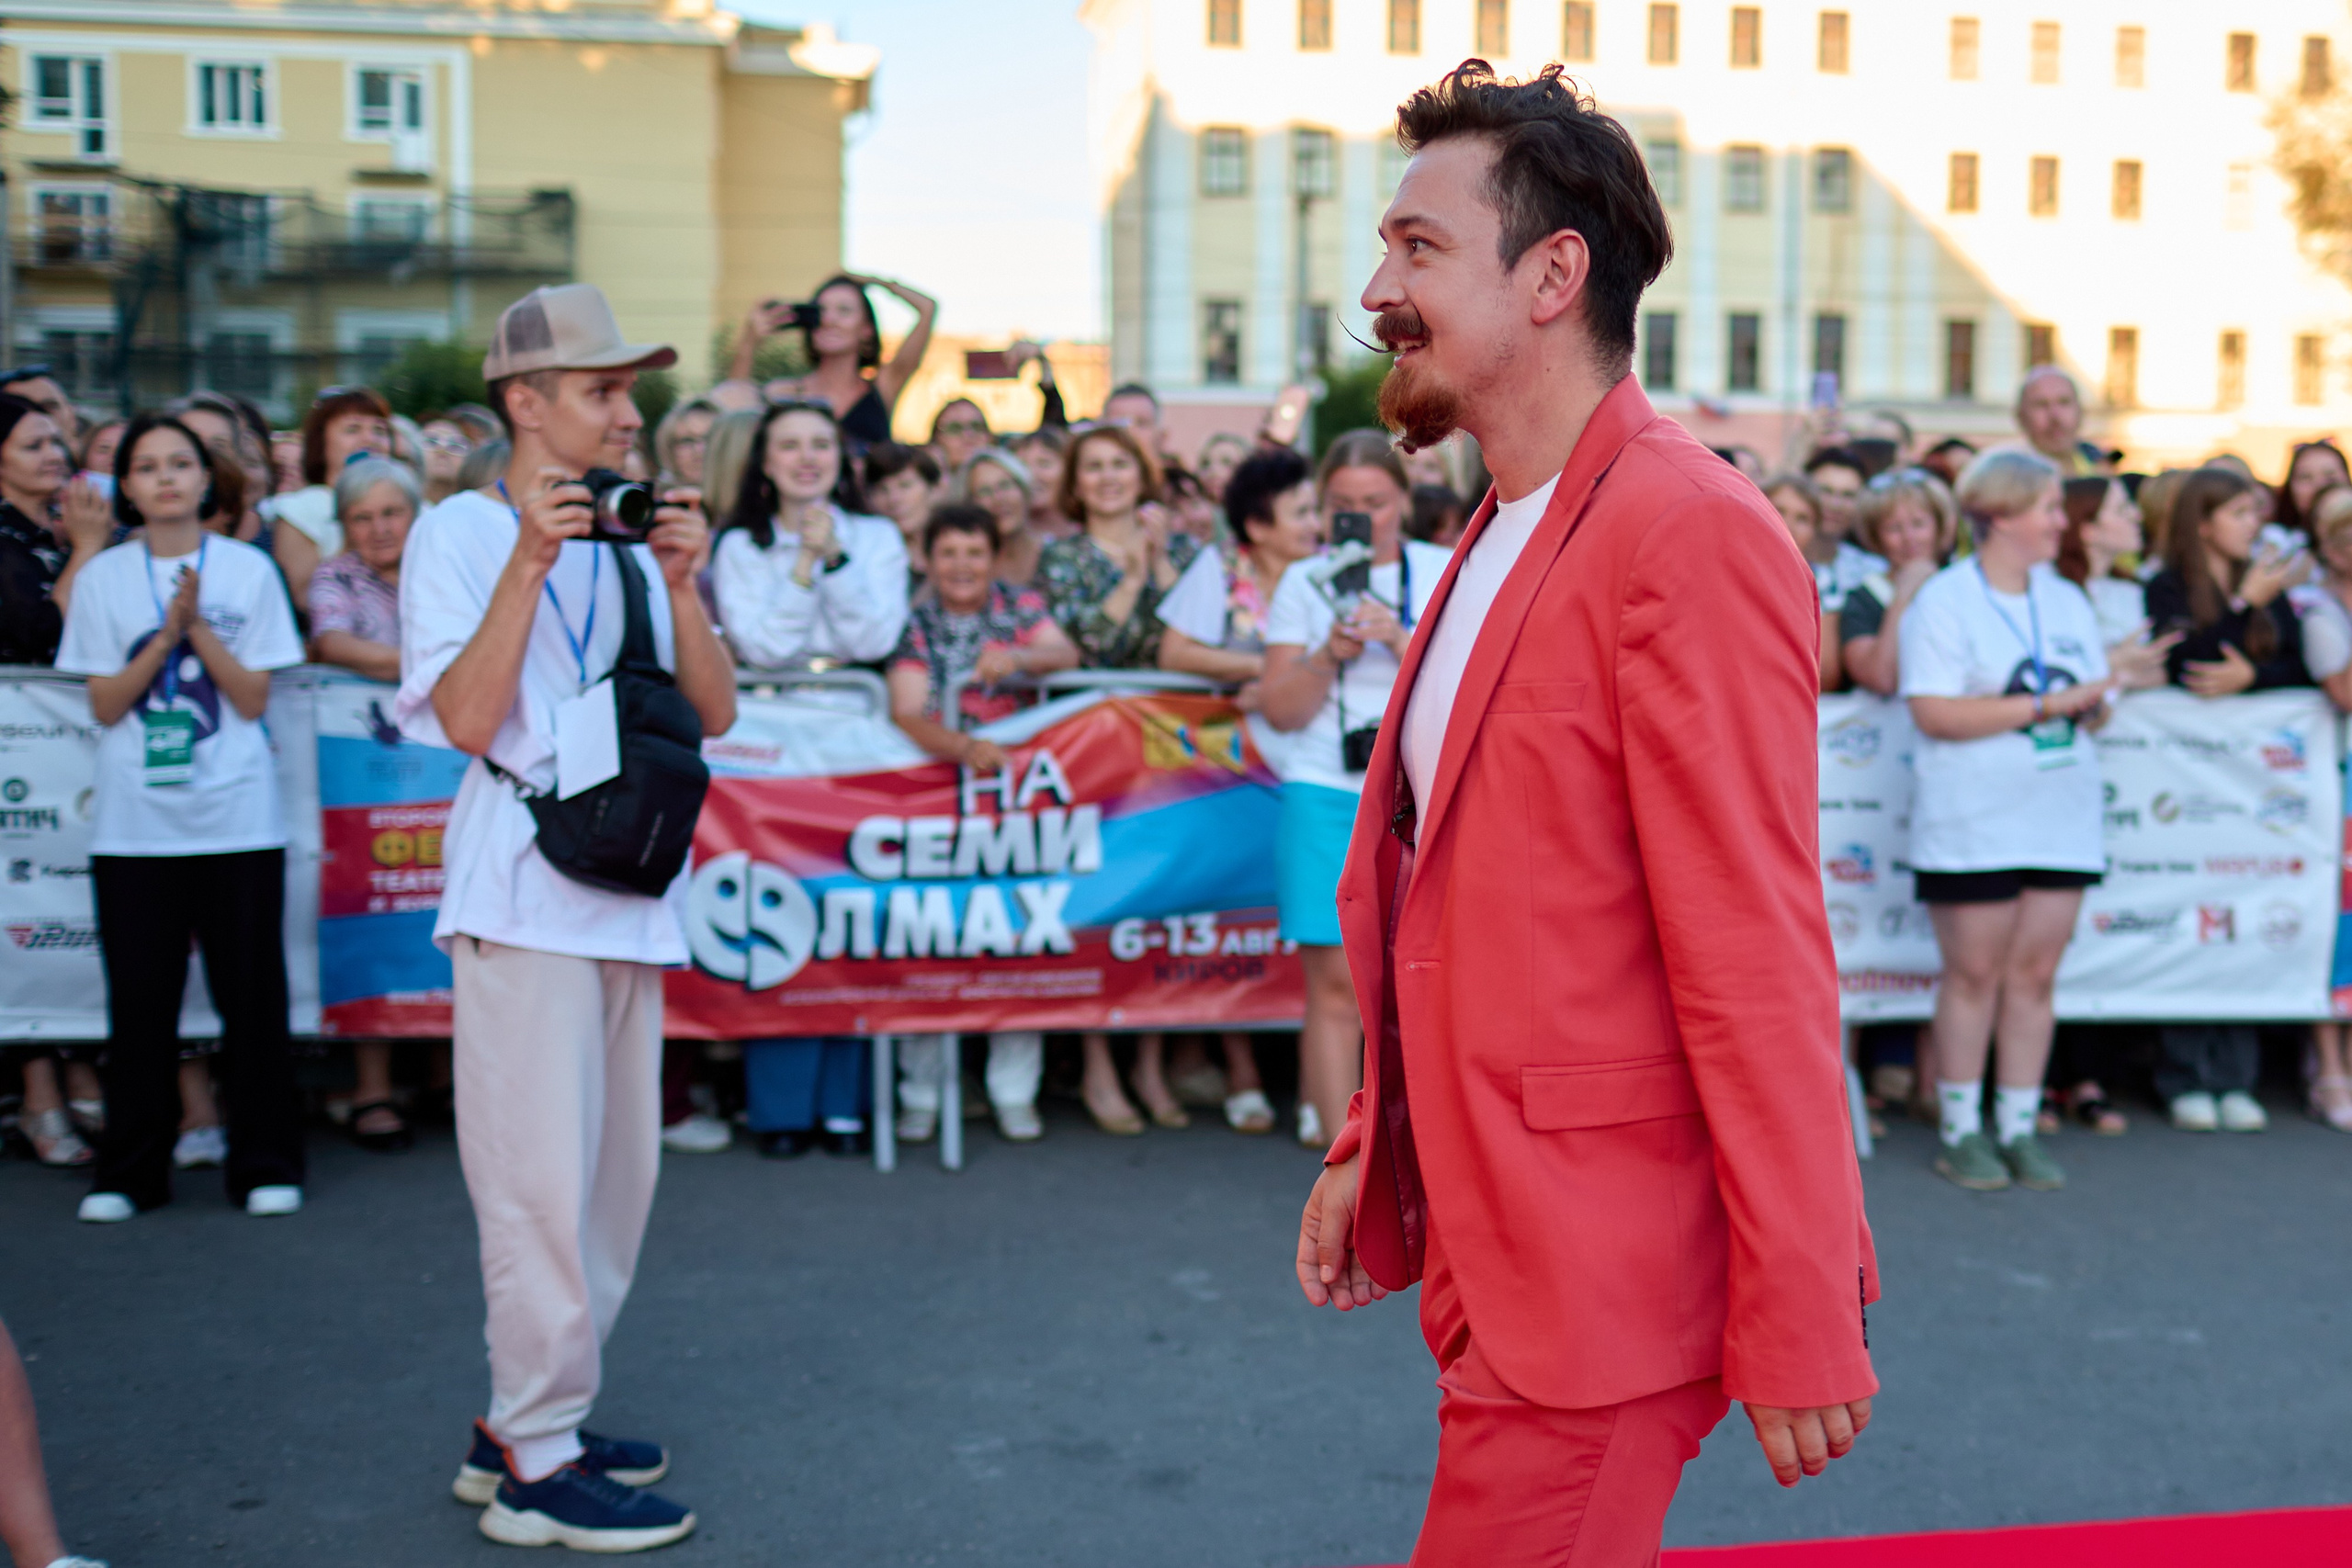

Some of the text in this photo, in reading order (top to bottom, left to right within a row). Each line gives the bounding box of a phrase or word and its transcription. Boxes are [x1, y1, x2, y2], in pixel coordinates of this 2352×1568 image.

[961, 749, 1073, 814] НА
[849, 804, 1102, 879] СЕМИ
[1110, 911, 1219, 963] 6-13
[1154, 959, 1266, 983] КИРОВ
